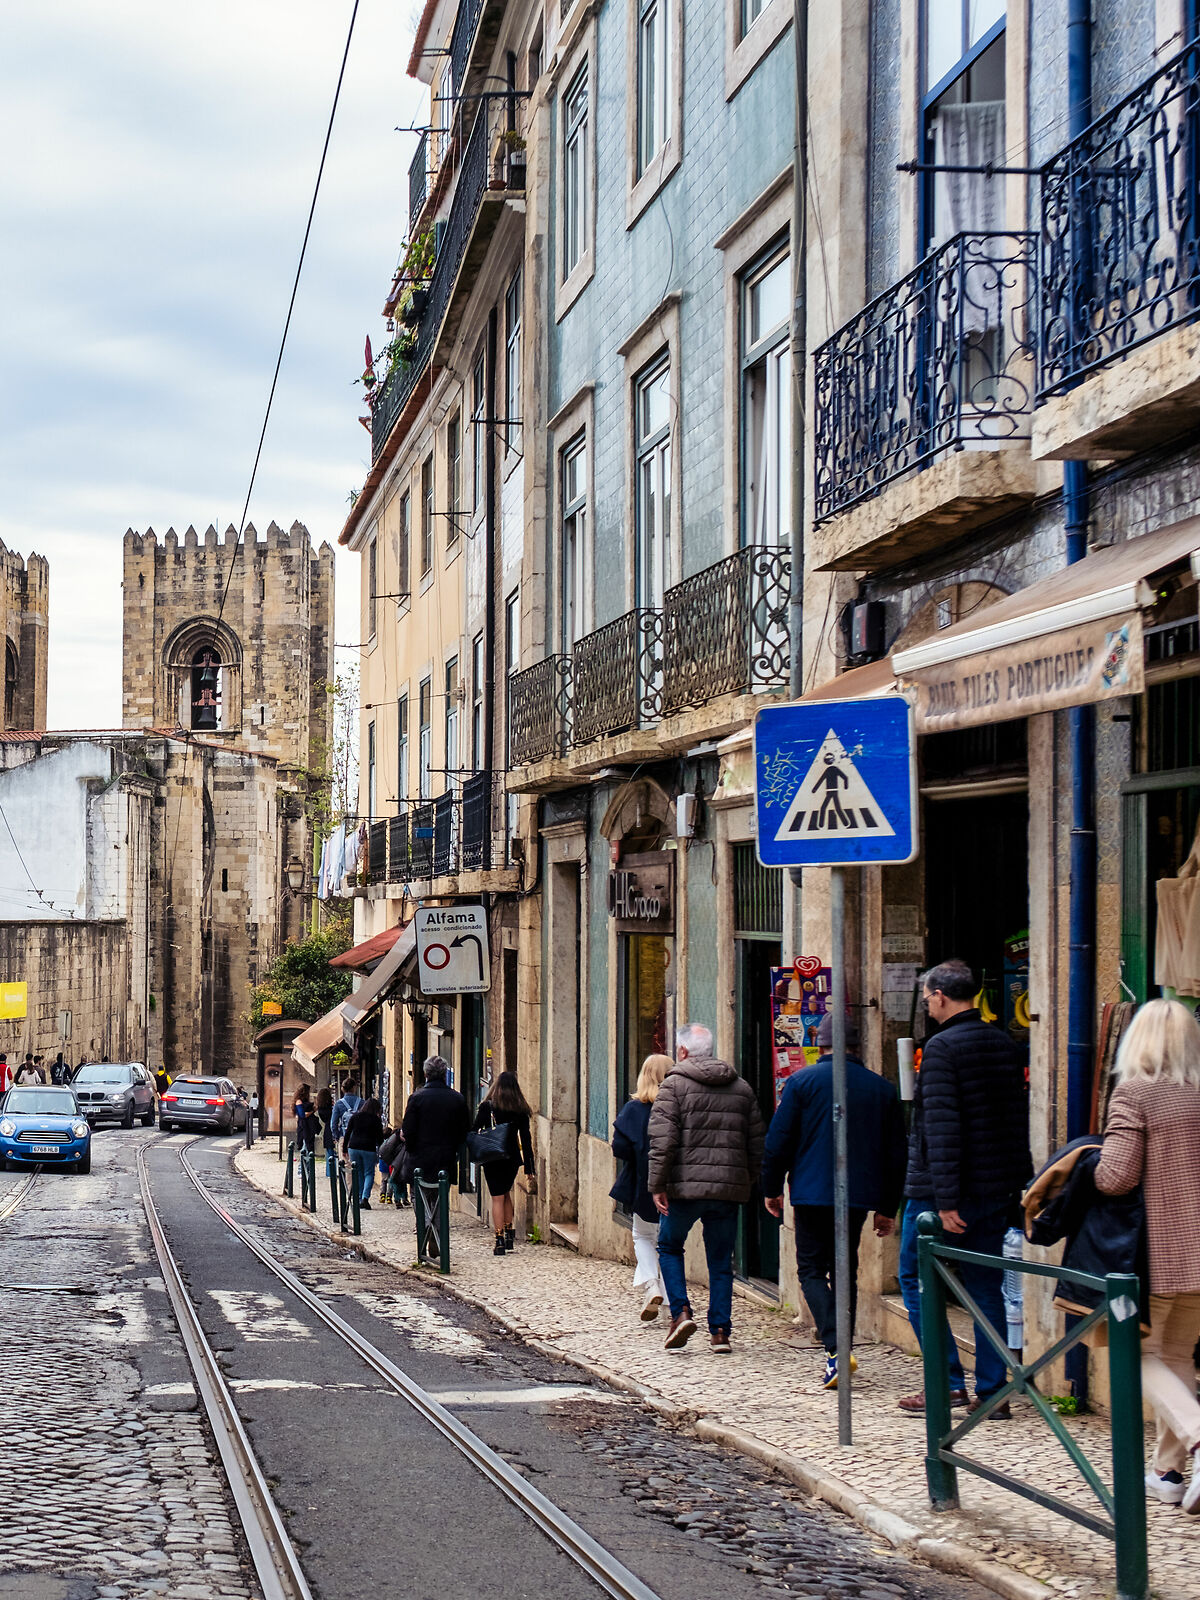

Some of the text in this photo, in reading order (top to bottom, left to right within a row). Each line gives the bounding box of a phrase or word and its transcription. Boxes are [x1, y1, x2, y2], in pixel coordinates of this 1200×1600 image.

[962, 669, 1000, 709] TILES
[426, 912, 476, 924] Alfama
[443, 924, 483, 932] condicionado
